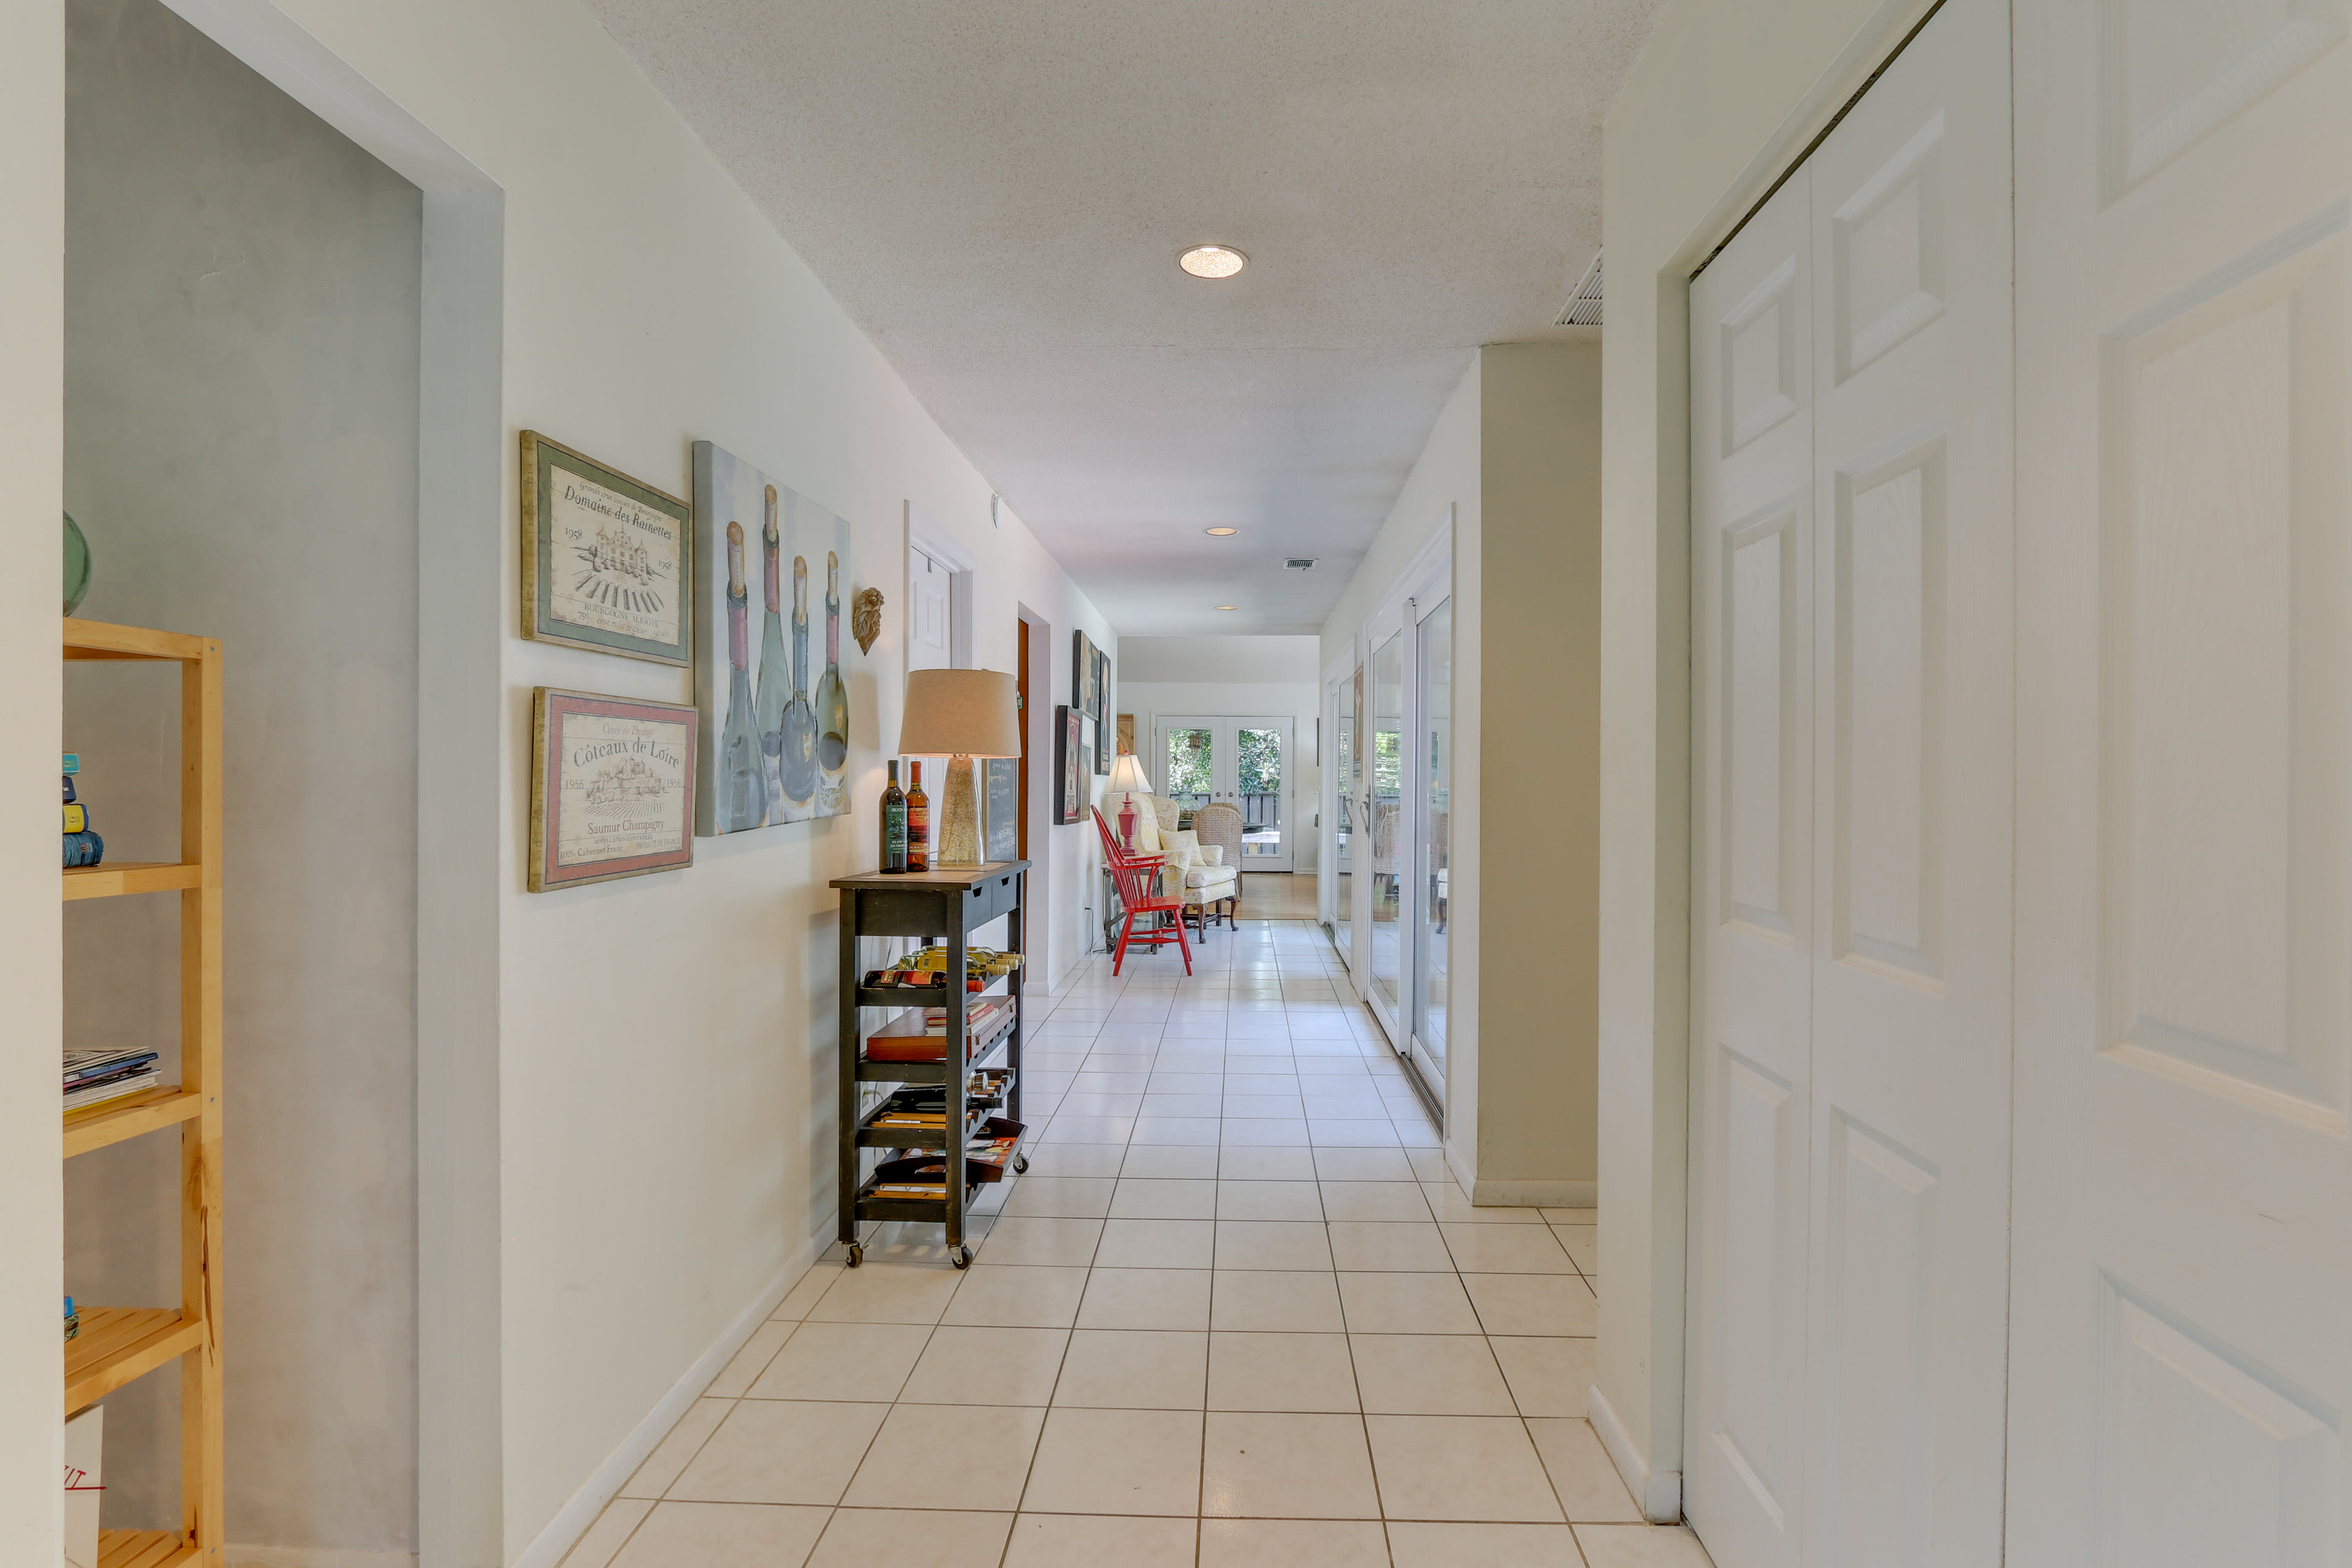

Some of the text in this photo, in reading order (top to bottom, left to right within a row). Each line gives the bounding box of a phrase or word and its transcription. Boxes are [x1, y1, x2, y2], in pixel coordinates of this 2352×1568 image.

[564, 484, 672, 540] Domaine des Rainettes
[565, 527, 583, 540] 1958
[658, 560, 672, 570] 1958
[584, 603, 630, 620] BOURGOGNE
[631, 725, 655, 739] Prestige
[573, 736, 679, 769] Côteaux de Loire
[565, 778, 584, 790] 1956
[666, 778, 681, 788] 1956
[587, 819, 665, 835] Saumur Champigny
[636, 841, 656, 850] PRODUIT
[664, 837, 680, 846] FRANCE
[578, 846, 606, 858] Cabernet
[607, 845, 623, 854] Franc
